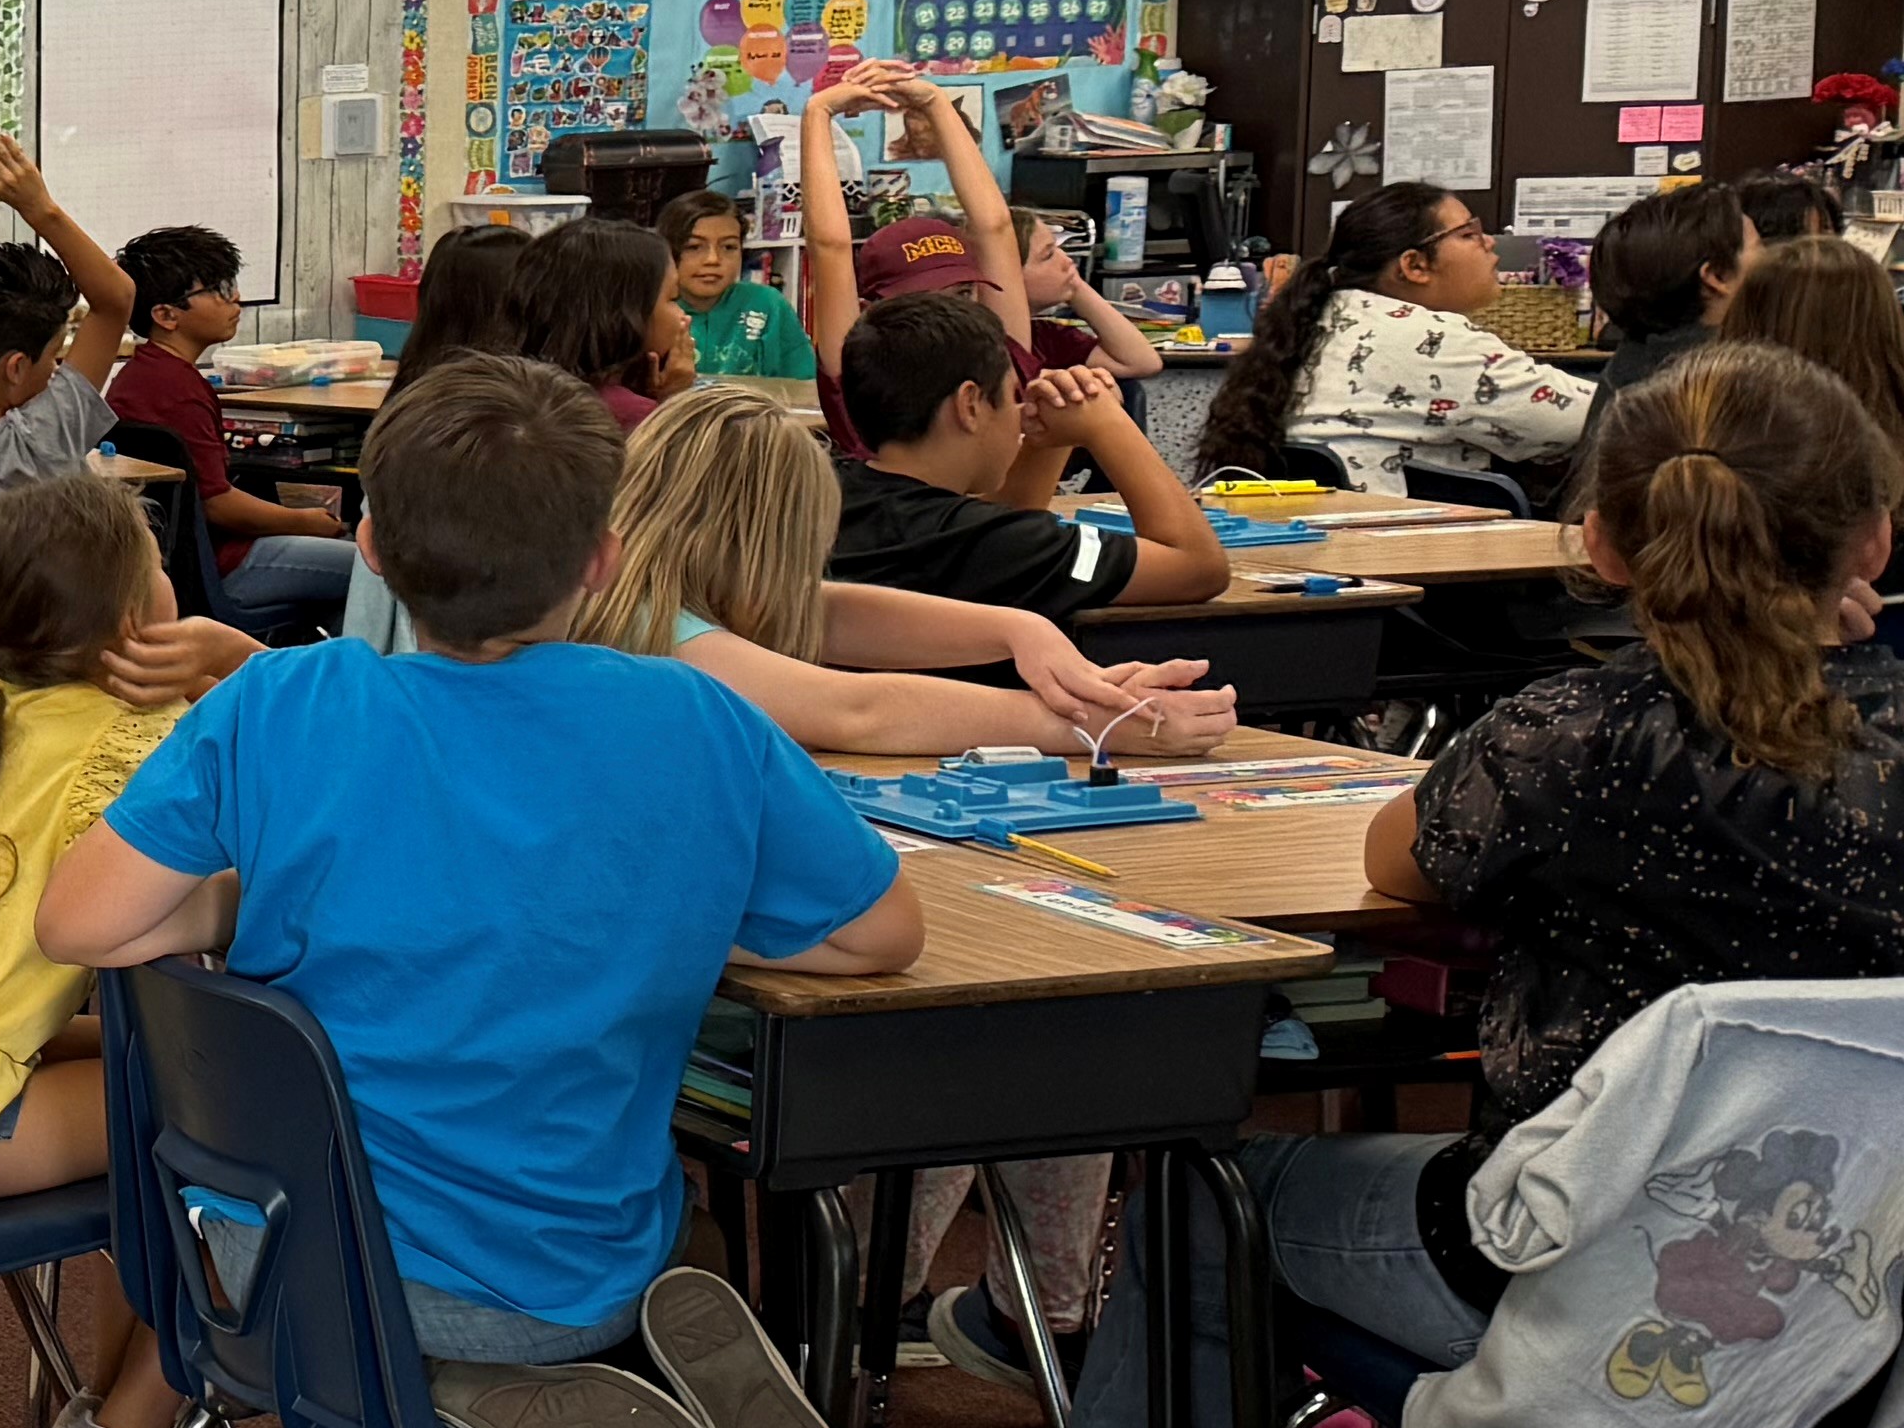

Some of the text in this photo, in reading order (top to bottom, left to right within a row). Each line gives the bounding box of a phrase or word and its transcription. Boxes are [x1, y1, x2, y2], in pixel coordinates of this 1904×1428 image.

[920, 1, 1106, 23] 21 22 23 24 25 26 27
[948, 37, 964, 50] 29
[976, 37, 993, 50] 30
[901, 234, 966, 263] MCB
